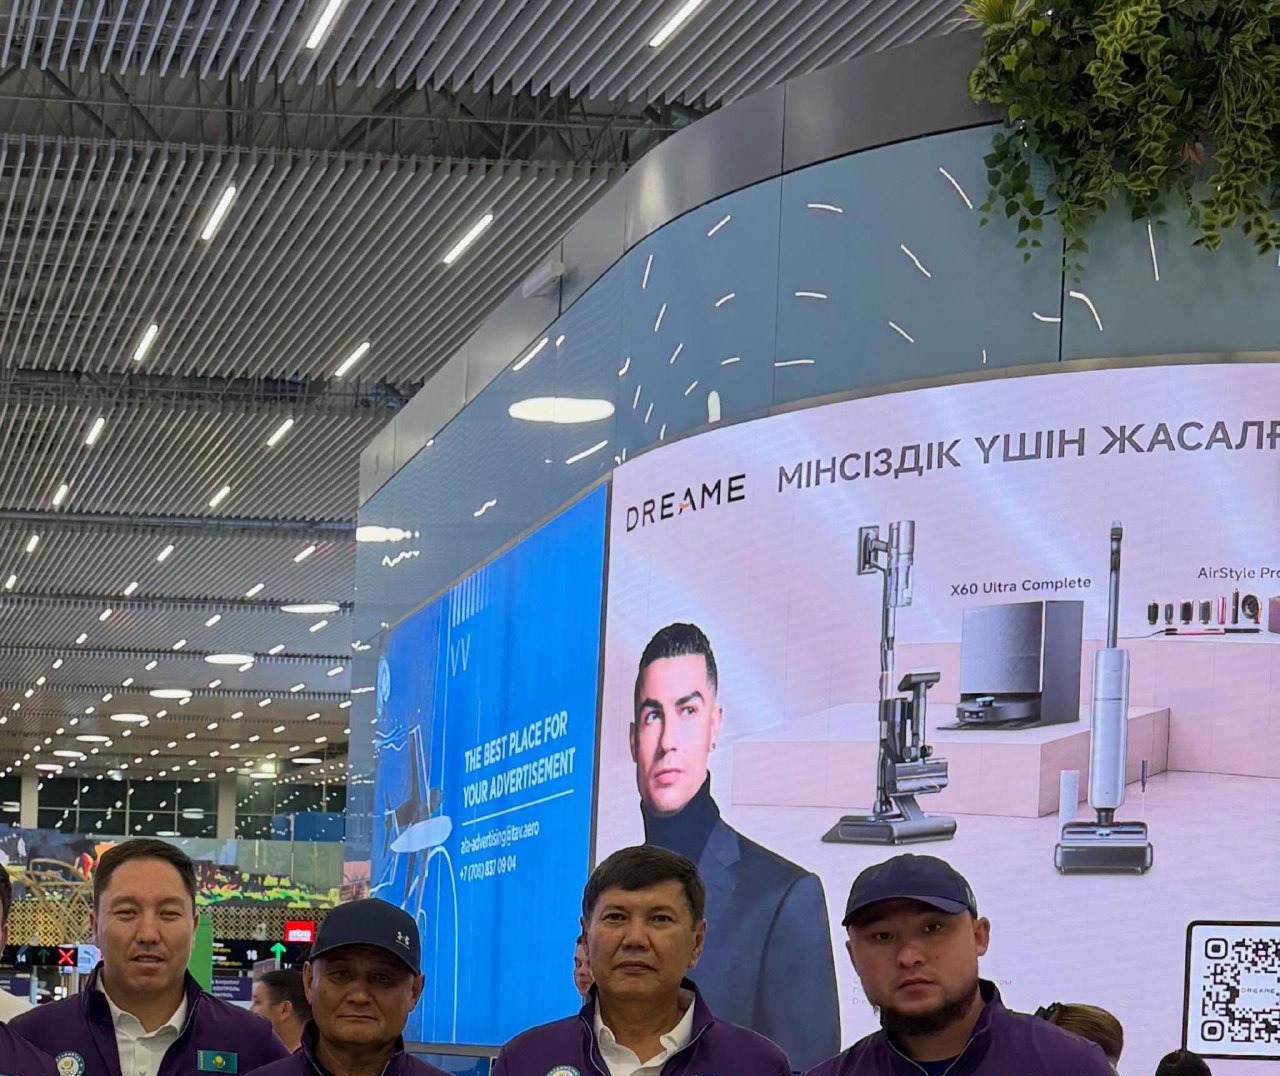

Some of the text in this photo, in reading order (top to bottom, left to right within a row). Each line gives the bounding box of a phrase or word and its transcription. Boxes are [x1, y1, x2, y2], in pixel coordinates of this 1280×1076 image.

[777, 438, 961, 493] МІНСІЗДІК
[974, 427, 1086, 464] ҮШІН
[625, 473, 747, 533] DREAME
[950, 576, 1092, 596] X60 Ultra Complete
[1197, 566, 1256, 581] AirStyle
[464, 710, 568, 773] THE BEST PLACE FOR
[463, 747, 576, 808] YOUR ADVERTISEMENT
[246, 949, 258, 961] 16
